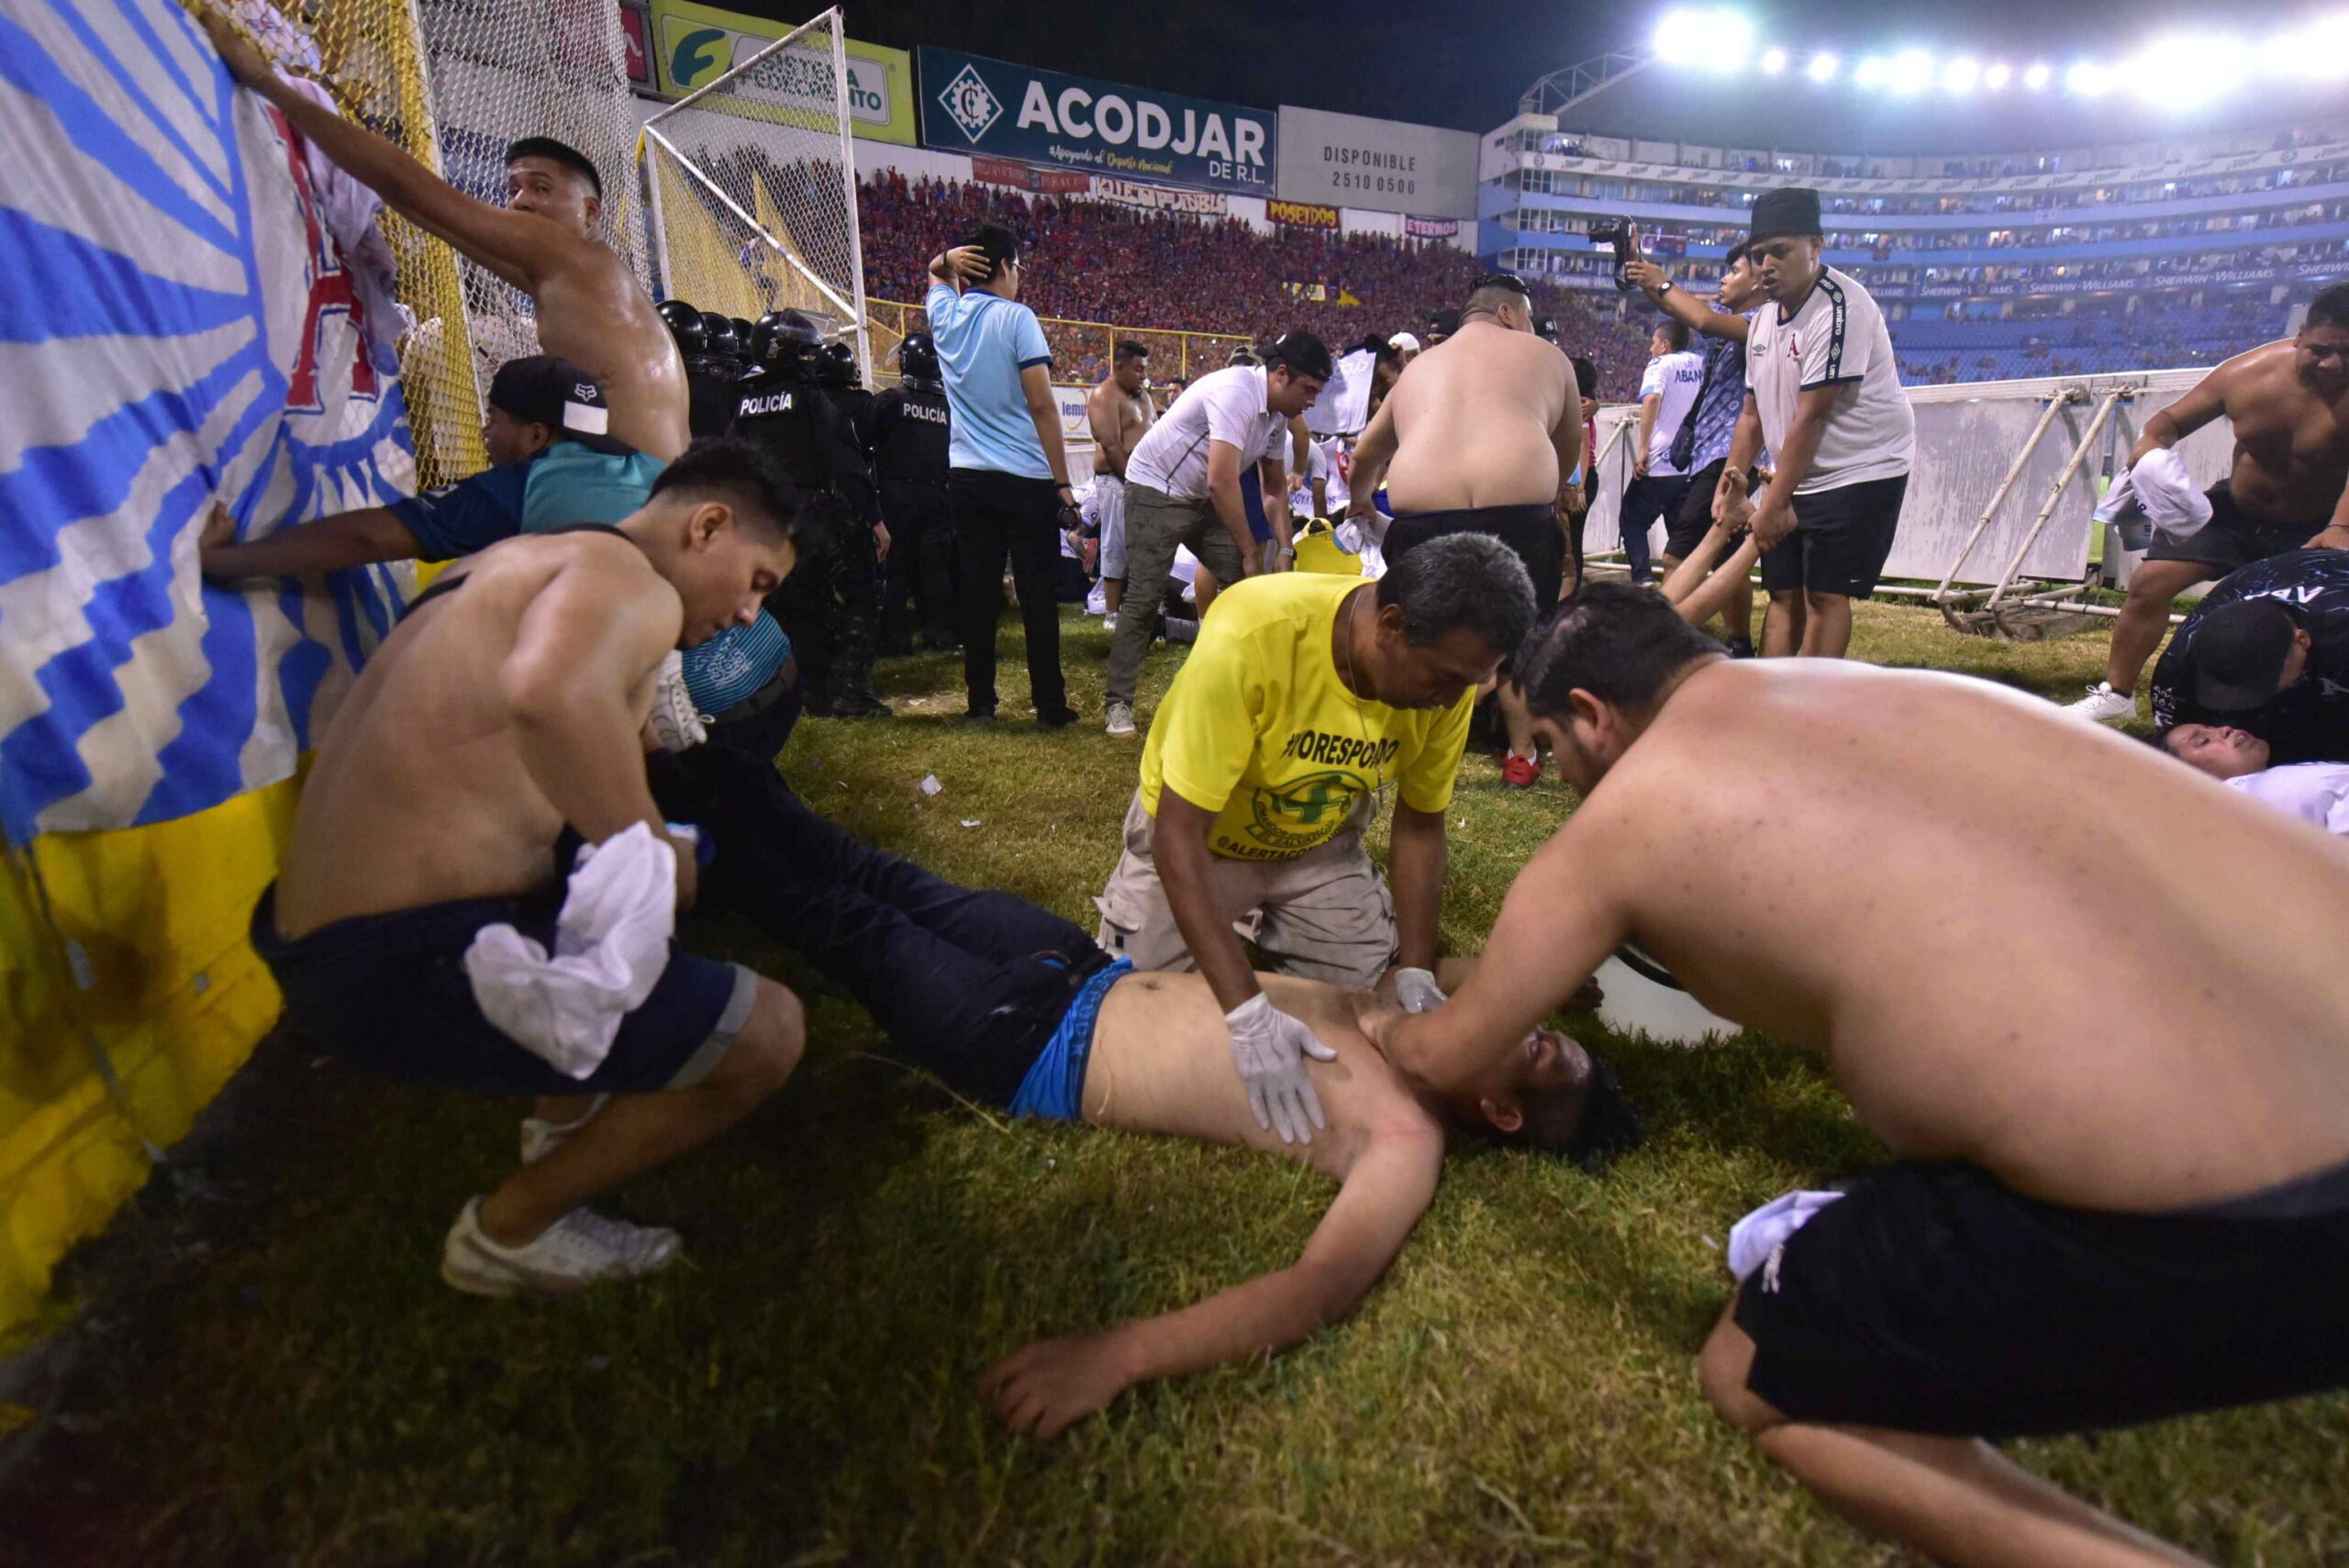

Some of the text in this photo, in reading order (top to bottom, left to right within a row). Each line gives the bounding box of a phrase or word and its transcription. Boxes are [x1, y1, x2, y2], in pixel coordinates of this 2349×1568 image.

[1016, 80, 1265, 166] ACODJAR
[1324, 146, 1416, 172] DISPONIBLE
[1208, 161, 1265, 184] DE R.L.
[1332, 171, 1416, 195] 2510 0500
[2296, 262, 2349, 276] SHERWI
[1835, 306, 1844, 336] umbro
[1675, 369, 1702, 383] ABAN
[740, 391, 793, 417] POLICÍA
[903, 403, 947, 425] POLICÍA
[1062, 401, 1087, 417] lemu
